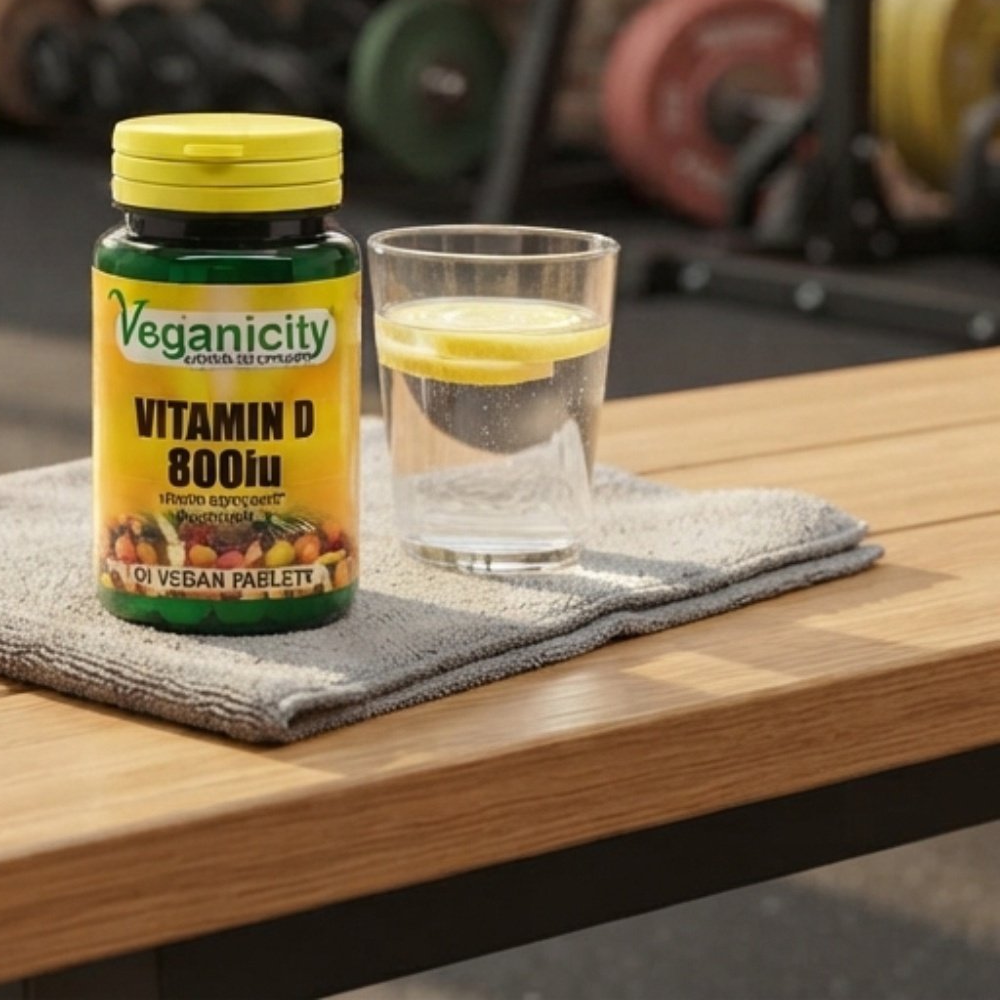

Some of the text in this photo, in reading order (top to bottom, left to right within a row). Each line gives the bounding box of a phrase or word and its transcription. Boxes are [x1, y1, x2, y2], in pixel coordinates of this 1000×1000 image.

[109, 289, 329, 360] Veganicity
[135, 397, 315, 441] VITAMIN D
